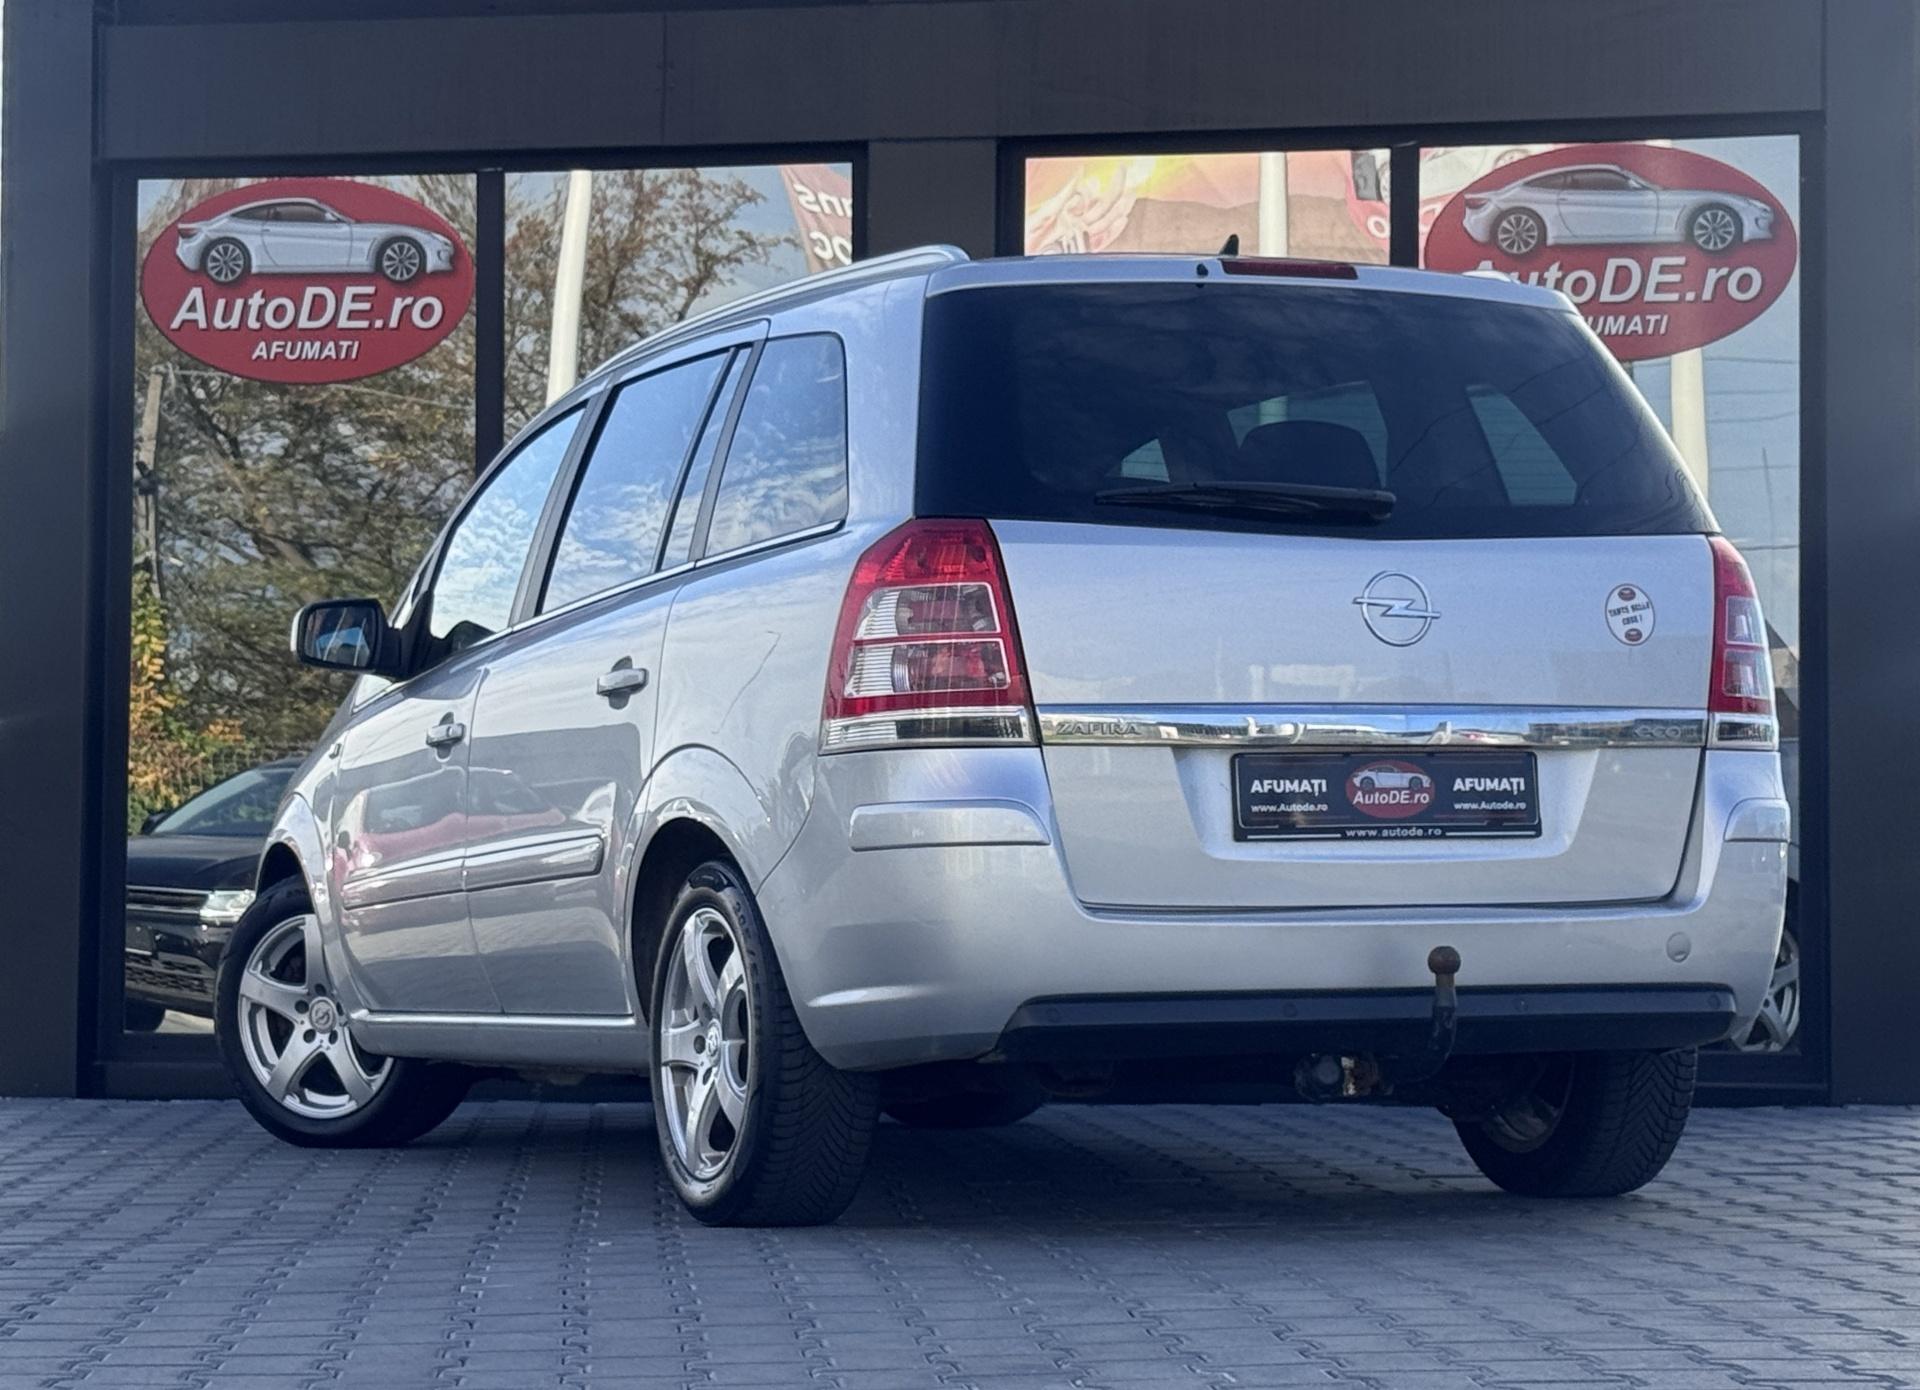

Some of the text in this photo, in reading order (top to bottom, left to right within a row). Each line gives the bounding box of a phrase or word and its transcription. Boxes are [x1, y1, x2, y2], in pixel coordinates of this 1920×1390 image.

[1476, 256, 1764, 303] toDE.ro
[170, 286, 444, 331] AutoDE.ro
[251, 340, 360, 361] AFUMATI
[1055, 720, 1141, 736] ZAFIRA
[1352, 789, 1430, 805] AutoDE.ro
[1453, 800, 1527, 810] www.Autode.ro
[1250, 802, 1329, 813] www.Autode.ro
[1345, 826, 1442, 838] www.autode.ro
